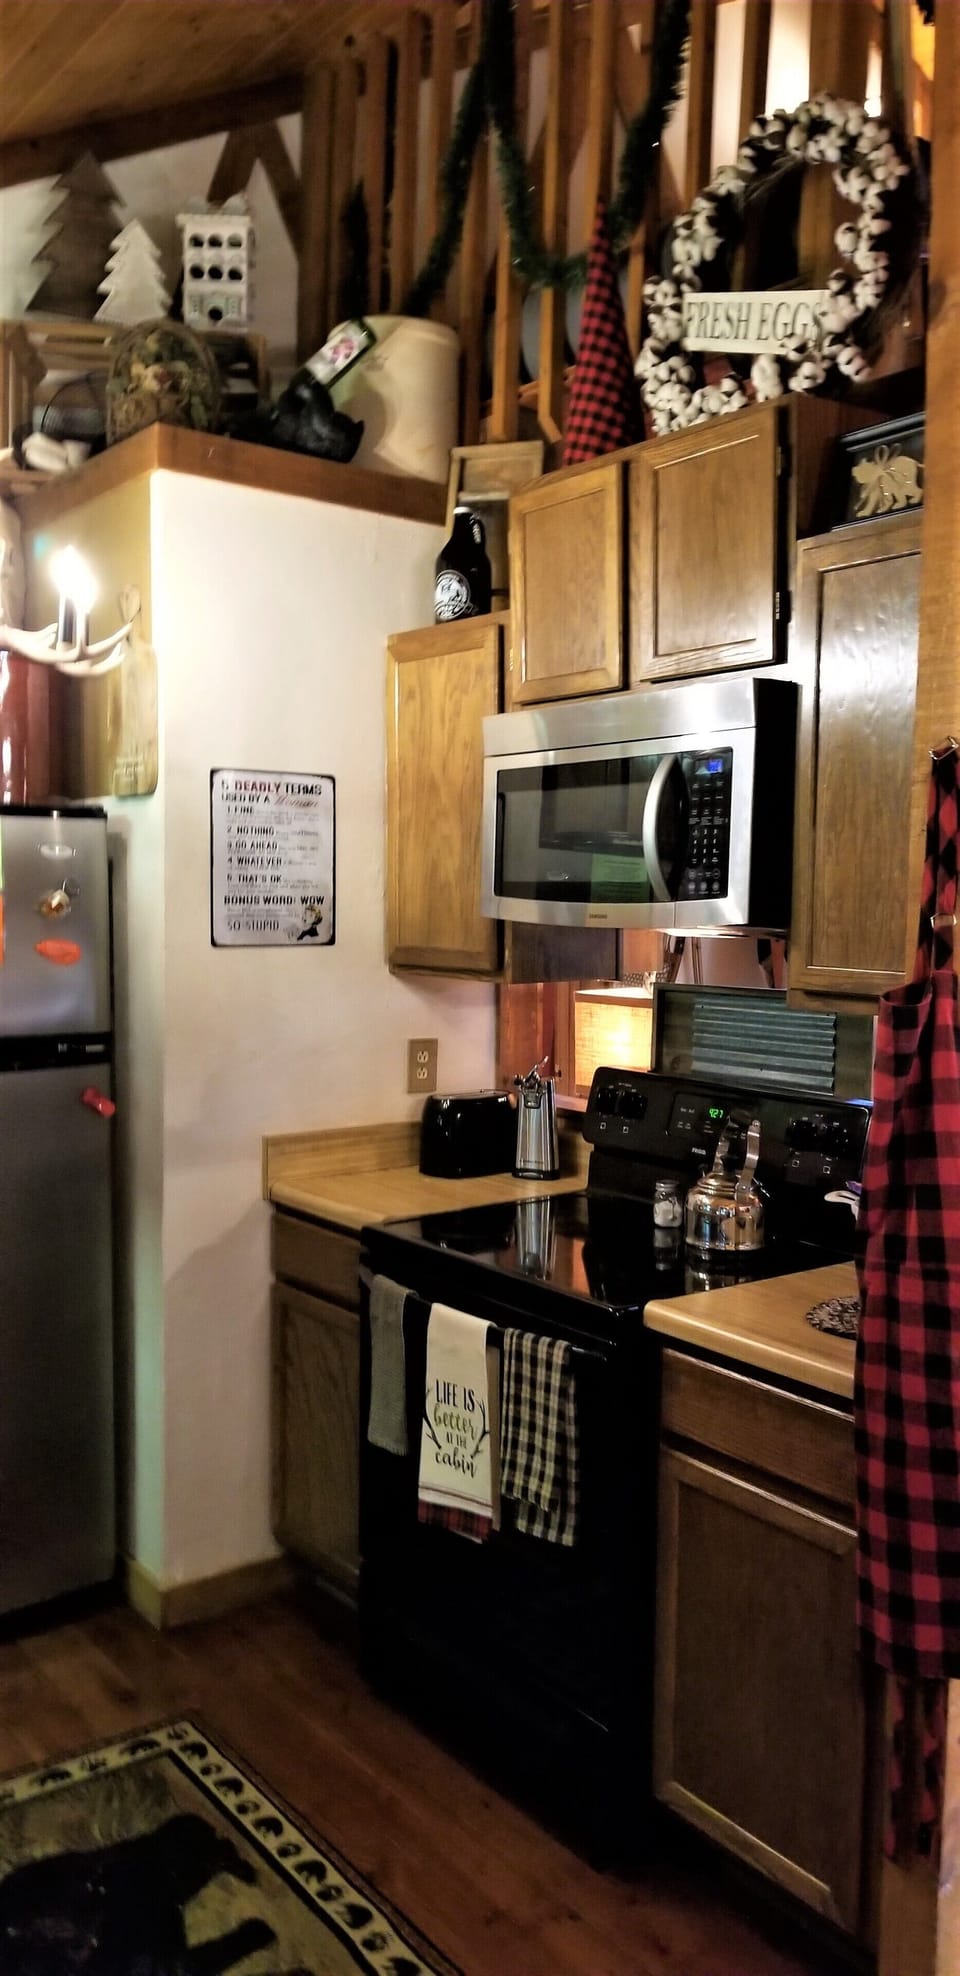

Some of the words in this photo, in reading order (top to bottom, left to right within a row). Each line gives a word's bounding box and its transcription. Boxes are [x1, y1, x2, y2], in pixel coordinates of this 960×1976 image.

[686, 302, 751, 340] FRESH
[235, 781, 281, 793] DEADLY
[284, 783, 322, 796] TERMS
[224, 895, 260, 905] BONUS
[300, 895, 325, 905] WOW
[436, 1379, 458, 1408] LIFE
[463, 1386, 475, 1413] IS
[433, 1403, 478, 1441] better
[435, 1446, 477, 1479] cabin
